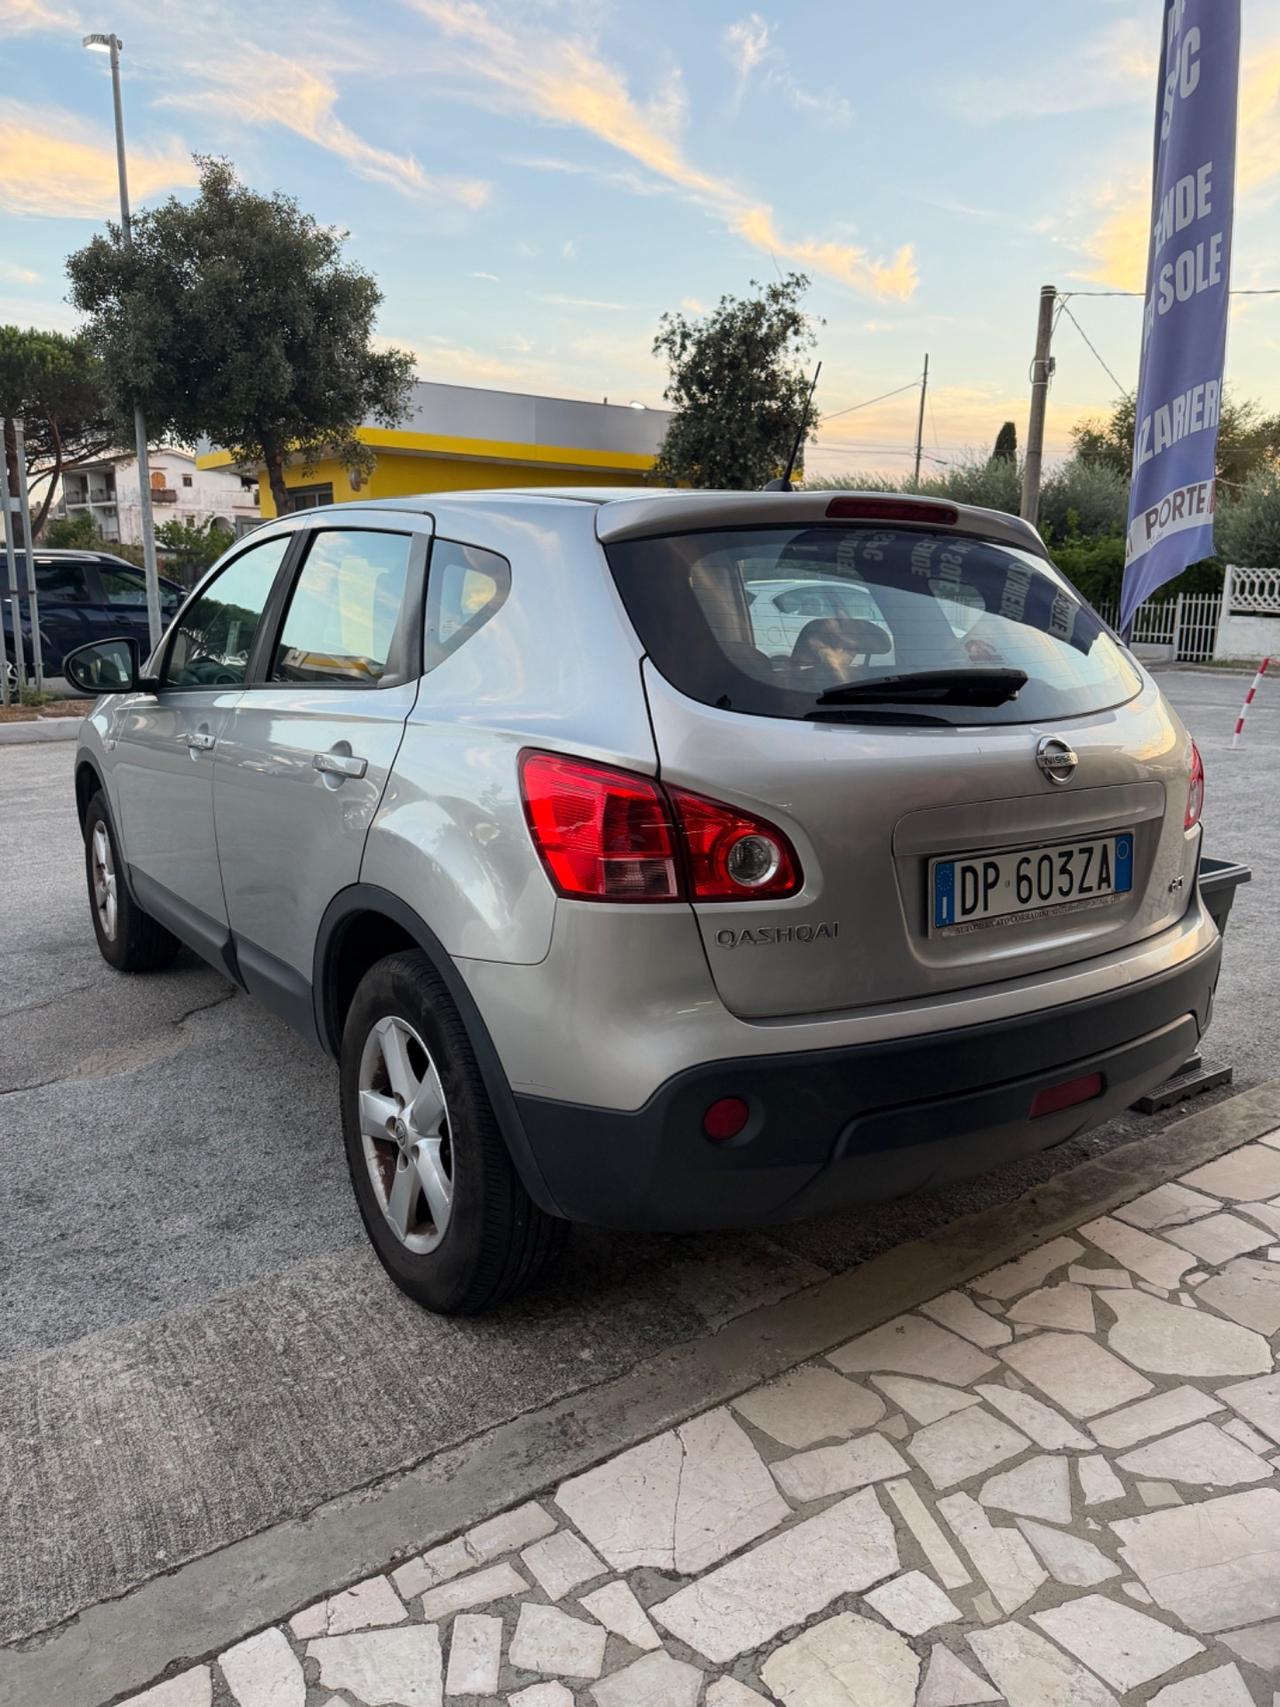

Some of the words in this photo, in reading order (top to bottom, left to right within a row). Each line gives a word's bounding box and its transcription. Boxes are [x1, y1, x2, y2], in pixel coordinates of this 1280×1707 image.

[1158, 232, 1222, 315] SOLE
[1145, 483, 1207, 540] PORTE
[960, 861, 1000, 916] DP
[1016, 843, 1112, 904] 603ZA
[715, 921, 840, 949] QASHQAI
